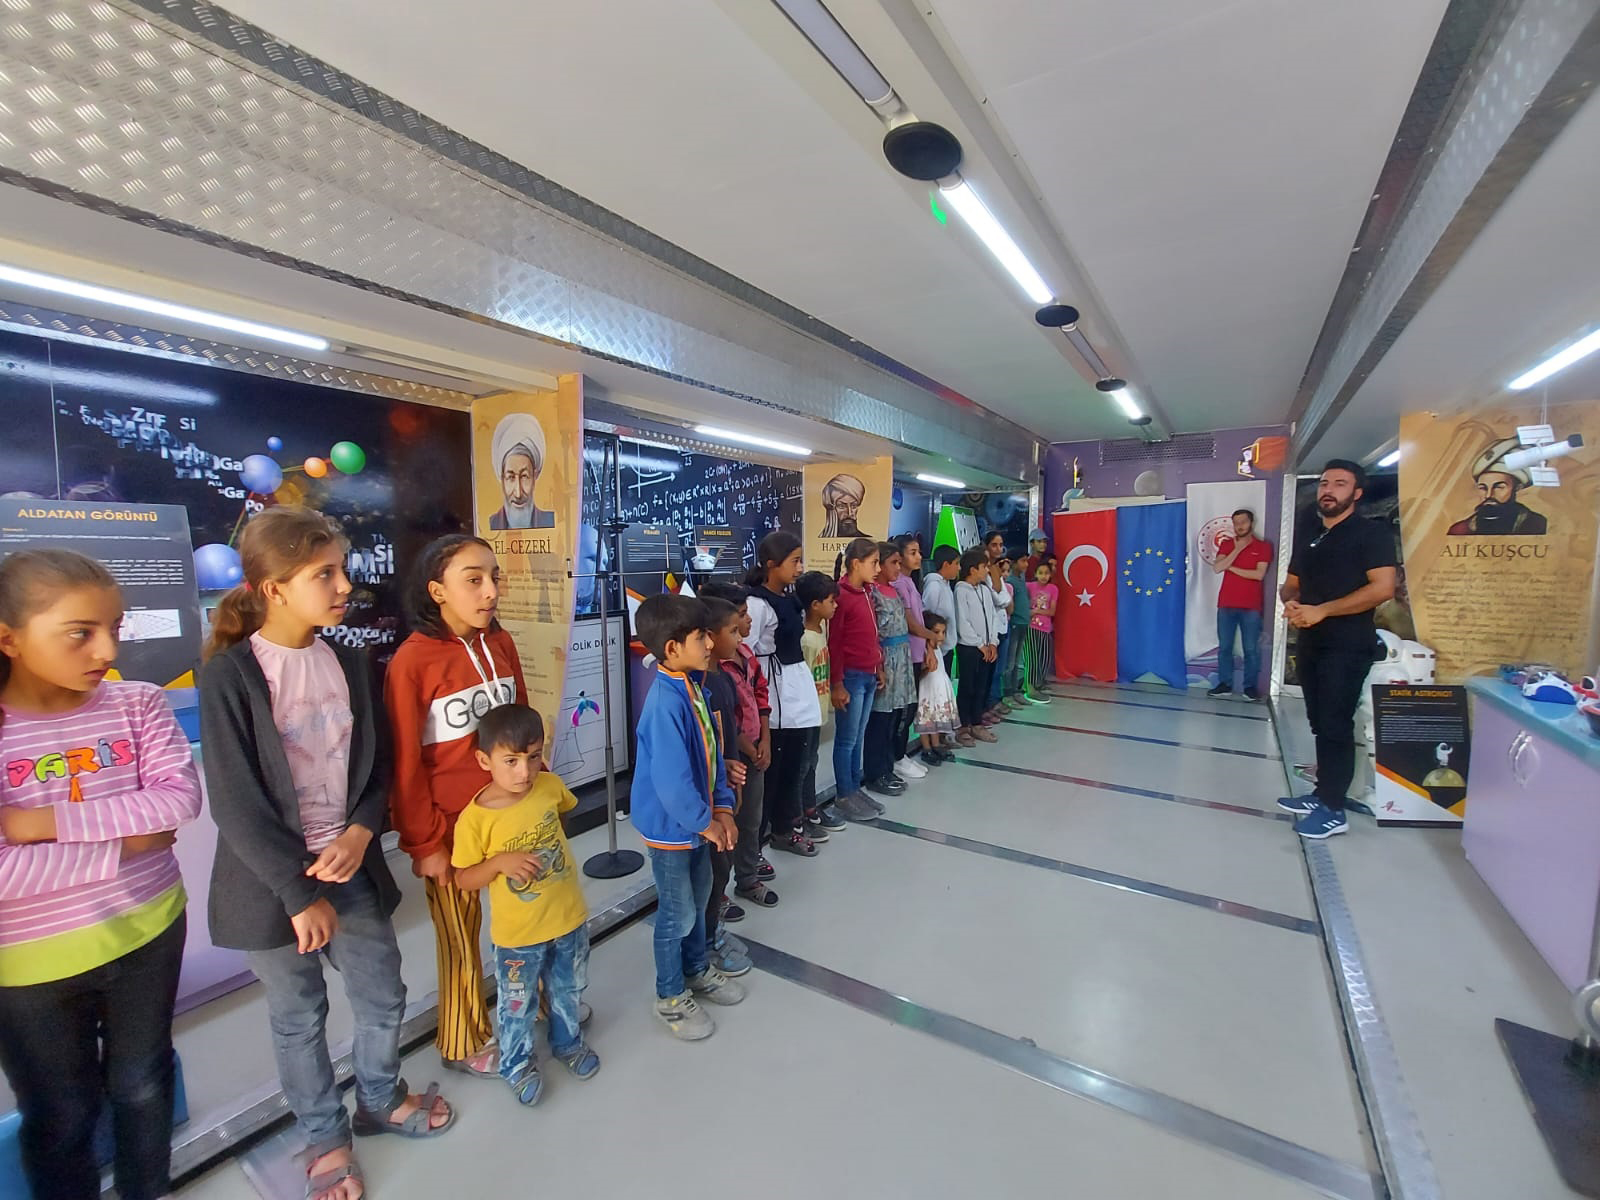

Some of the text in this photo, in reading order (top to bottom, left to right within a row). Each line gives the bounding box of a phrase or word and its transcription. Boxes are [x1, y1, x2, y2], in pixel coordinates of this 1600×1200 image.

[180, 417, 196, 431] Si
[220, 457, 243, 471] Ga
[224, 486, 246, 499] Ga
[18, 508, 158, 522] ALDATAN GÖRÜNTÜ
[494, 536, 551, 555] EL-CEZERİ
[1474, 544, 1550, 561] KUŞCU
[374, 544, 394, 562] Si
[572, 639, 592, 651] OLİK
